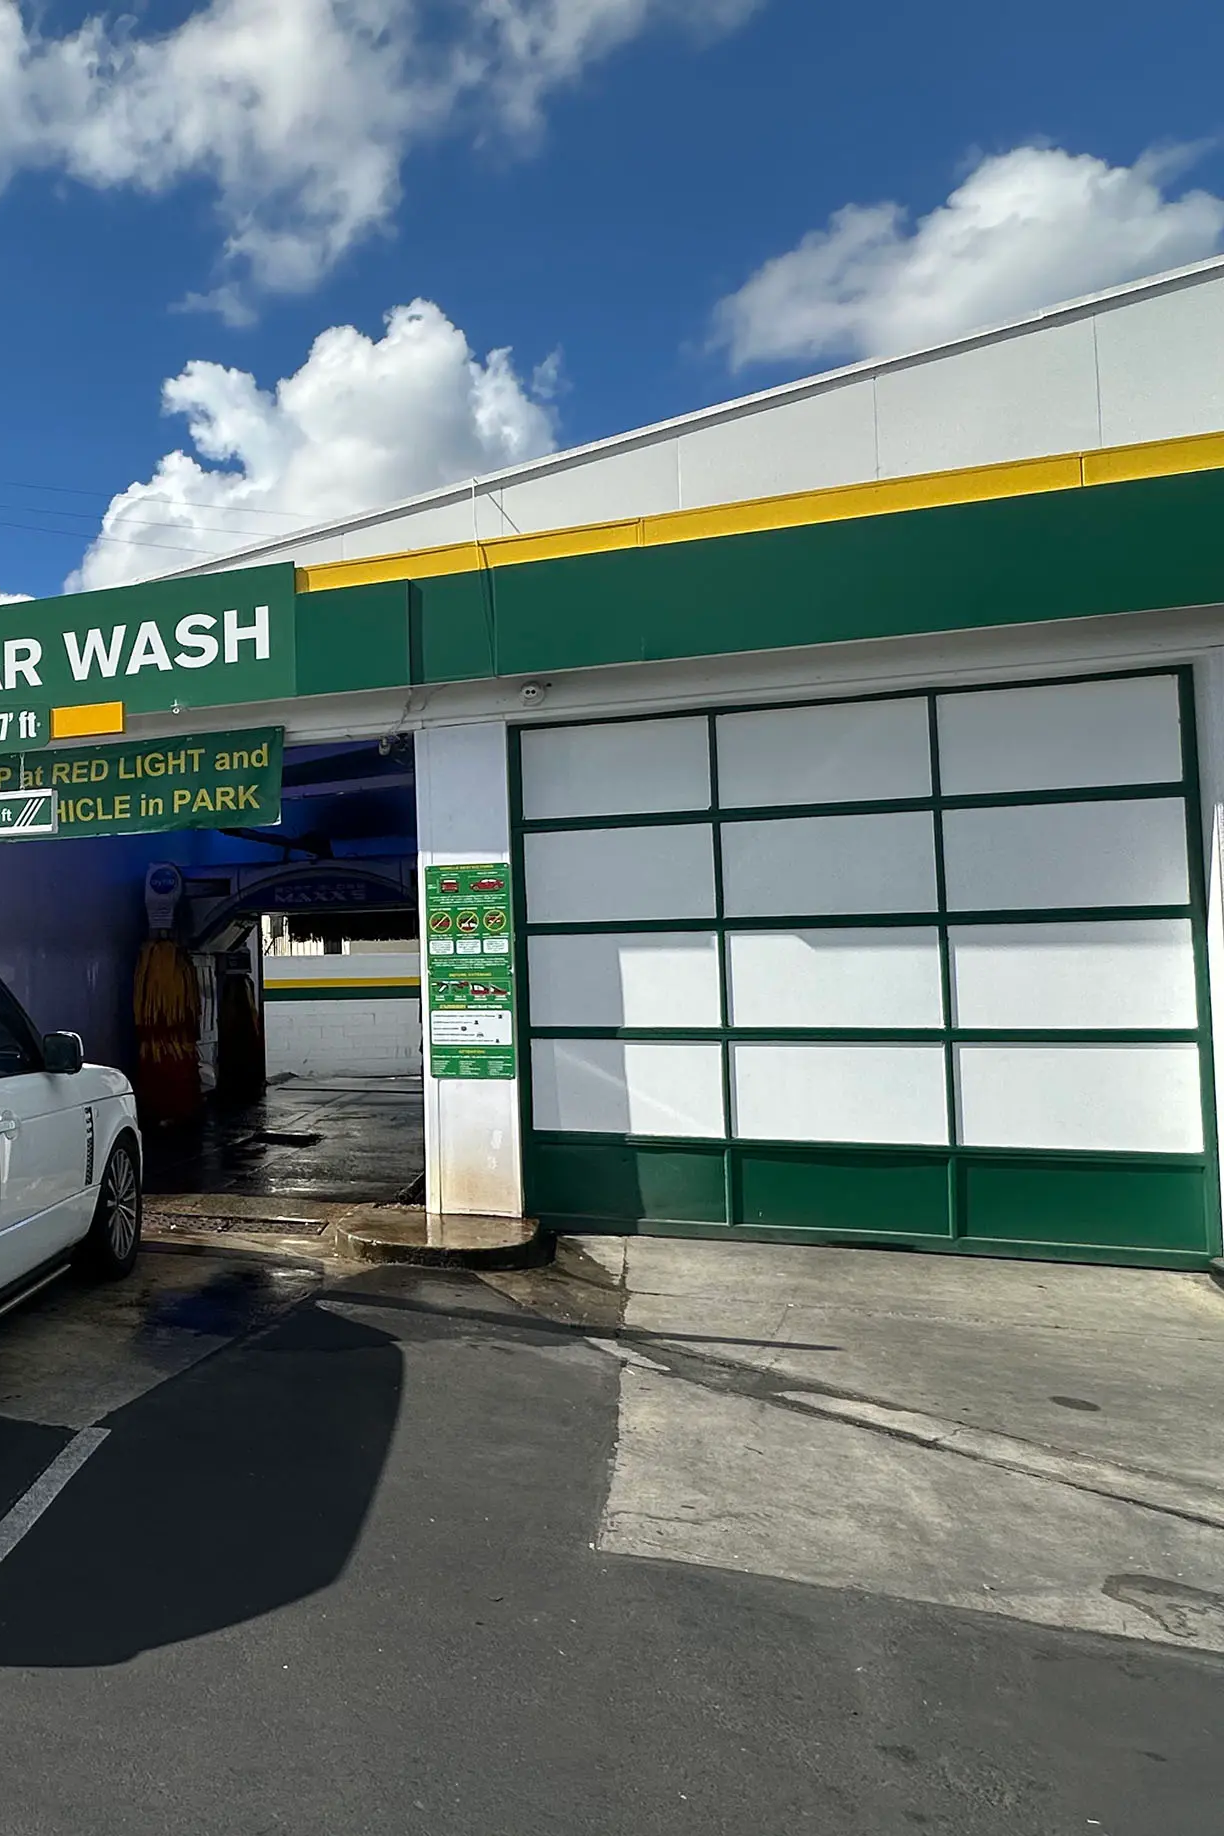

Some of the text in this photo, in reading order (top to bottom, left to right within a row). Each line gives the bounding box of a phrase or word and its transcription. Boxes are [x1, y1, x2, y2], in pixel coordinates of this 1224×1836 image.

[63, 605, 271, 682] WASH
[19, 711, 37, 739] ft
[23, 765, 43, 787] at
[52, 759, 109, 785] RED
[118, 748, 206, 779] LIGHT
[214, 743, 269, 772] and
[2, 808, 13, 822] ft
[56, 784, 261, 823] HICLE in PARK
